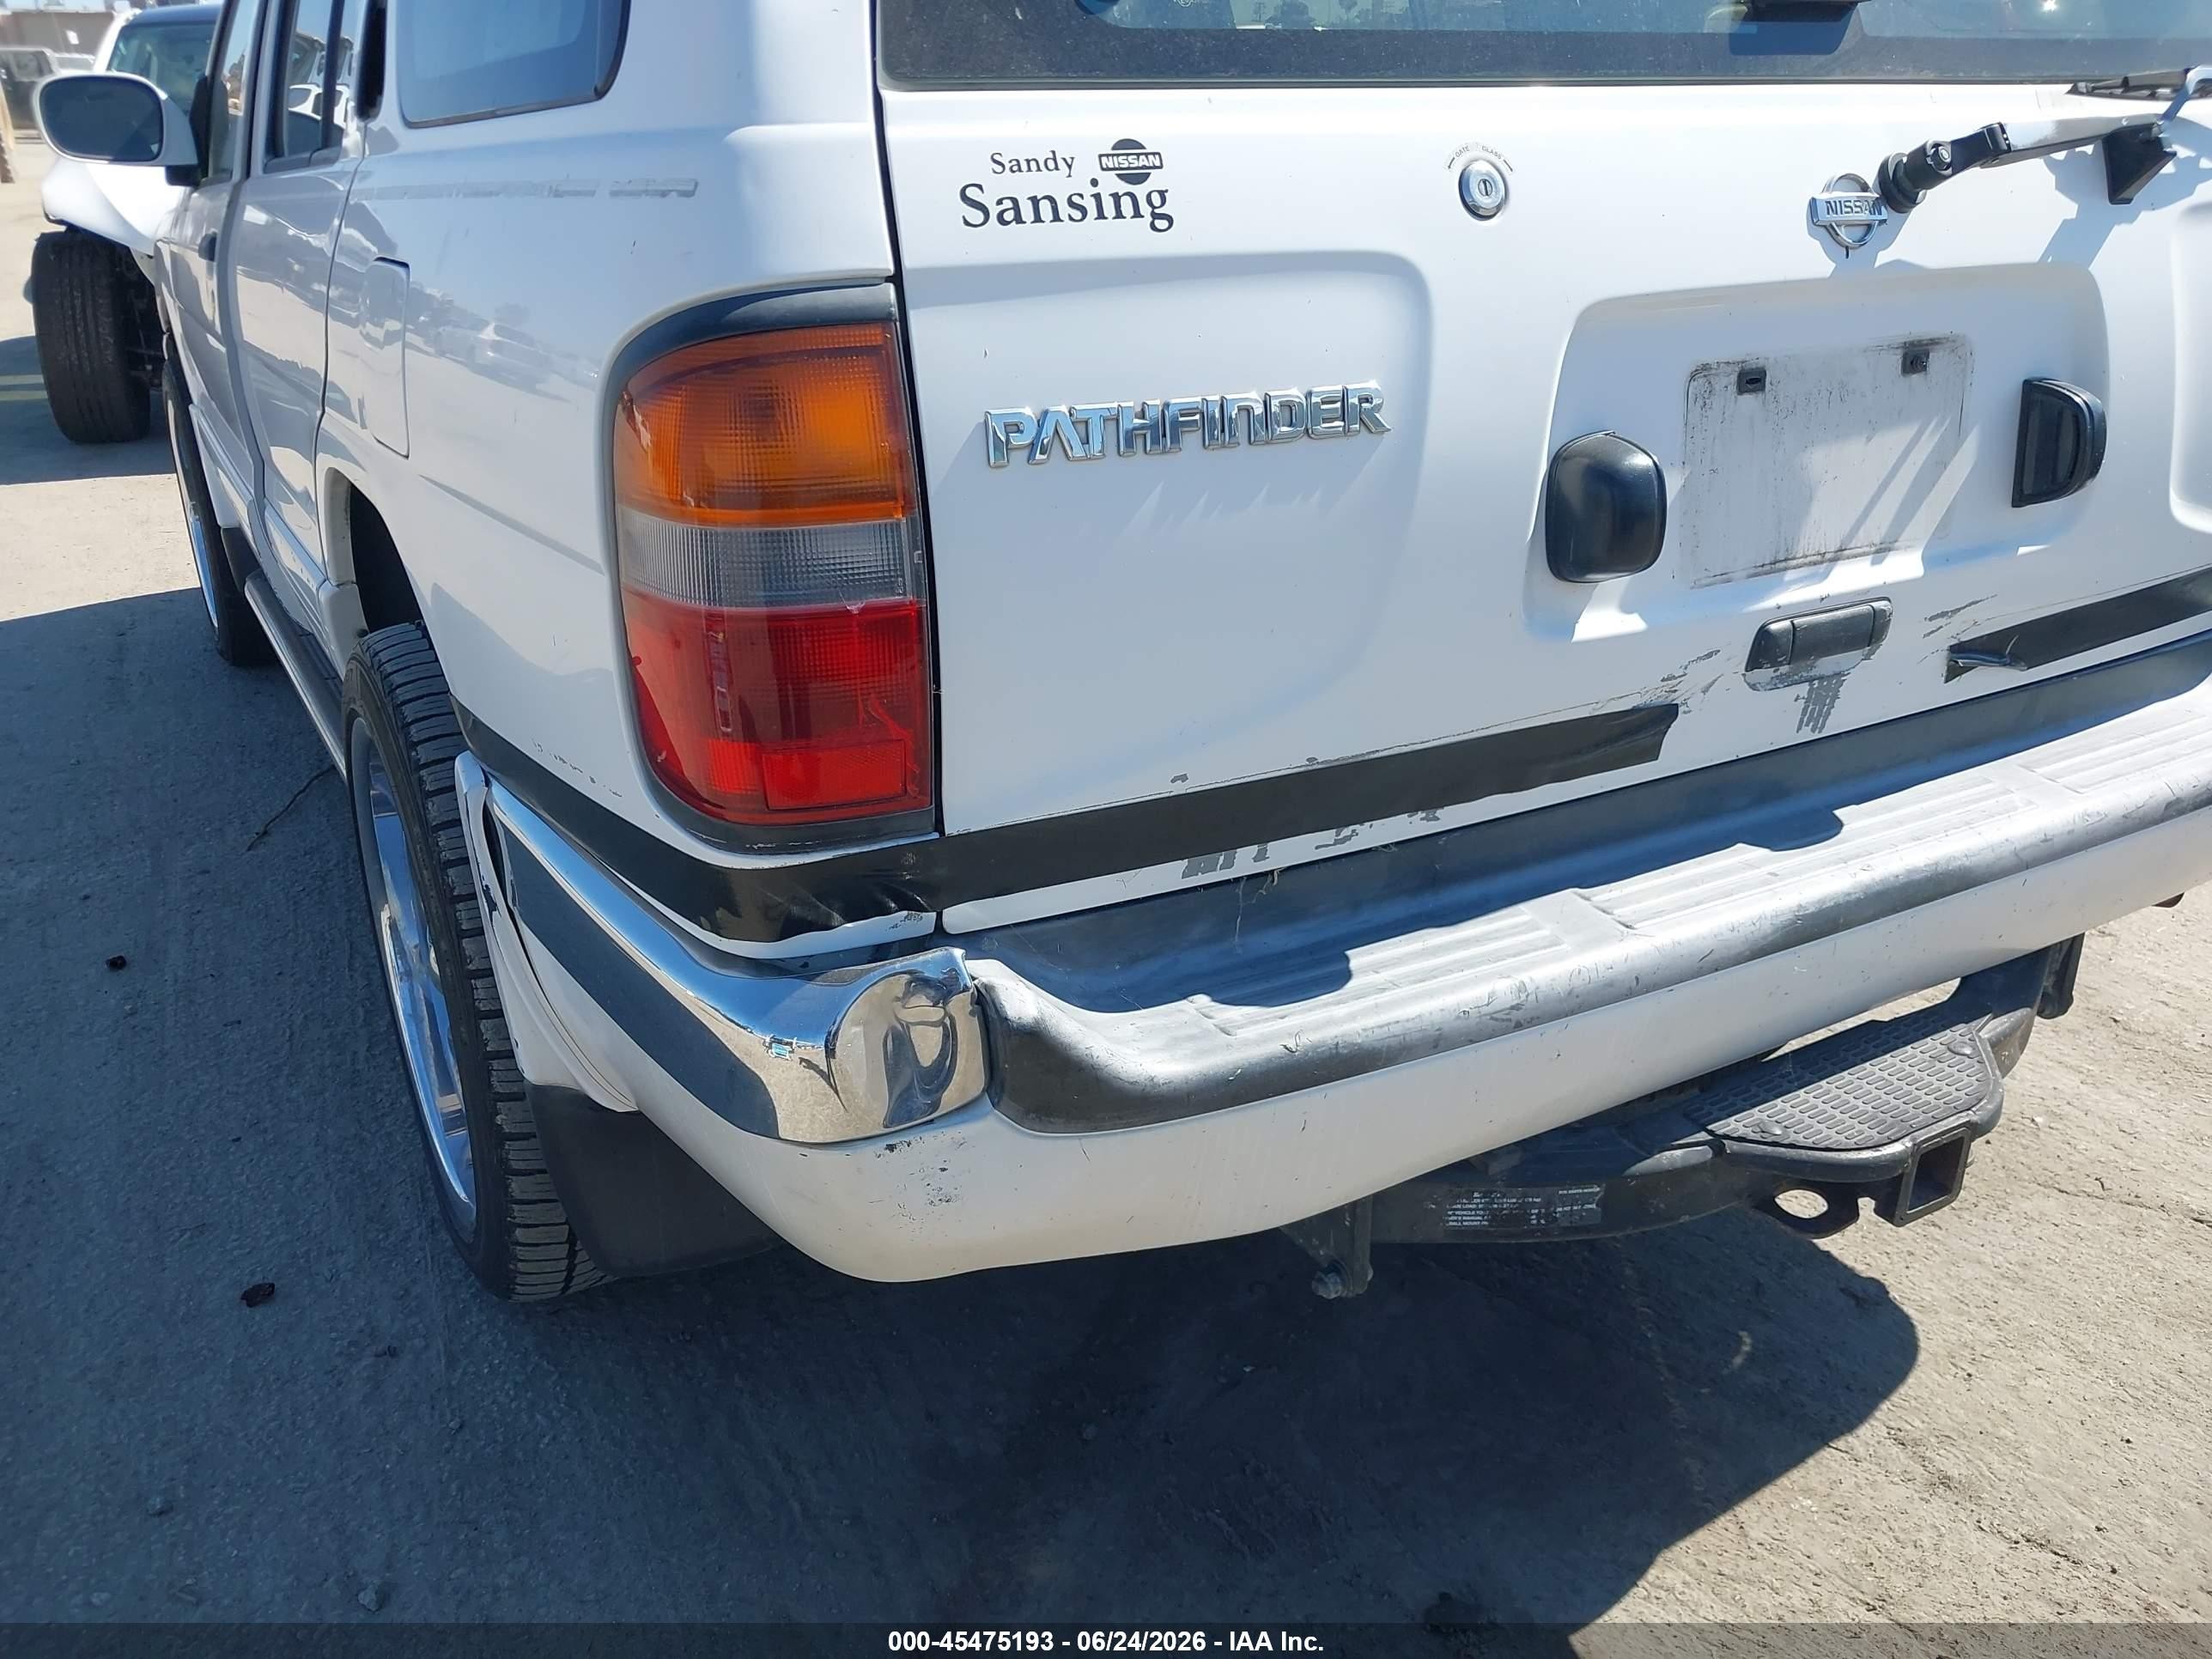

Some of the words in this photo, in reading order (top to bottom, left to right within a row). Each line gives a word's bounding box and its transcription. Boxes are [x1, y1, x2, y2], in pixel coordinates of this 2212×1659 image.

[1455, 144, 1470, 158] GATE
[1481, 145, 1501, 160] GLASS
[990, 149, 1076, 178] Sandy
[1101, 153, 1161, 170] NISSAN
[958, 177, 1175, 233] Sansing
[1825, 199, 1884, 216] NISSAN
[984, 380, 1393, 468] PATHFINDER
